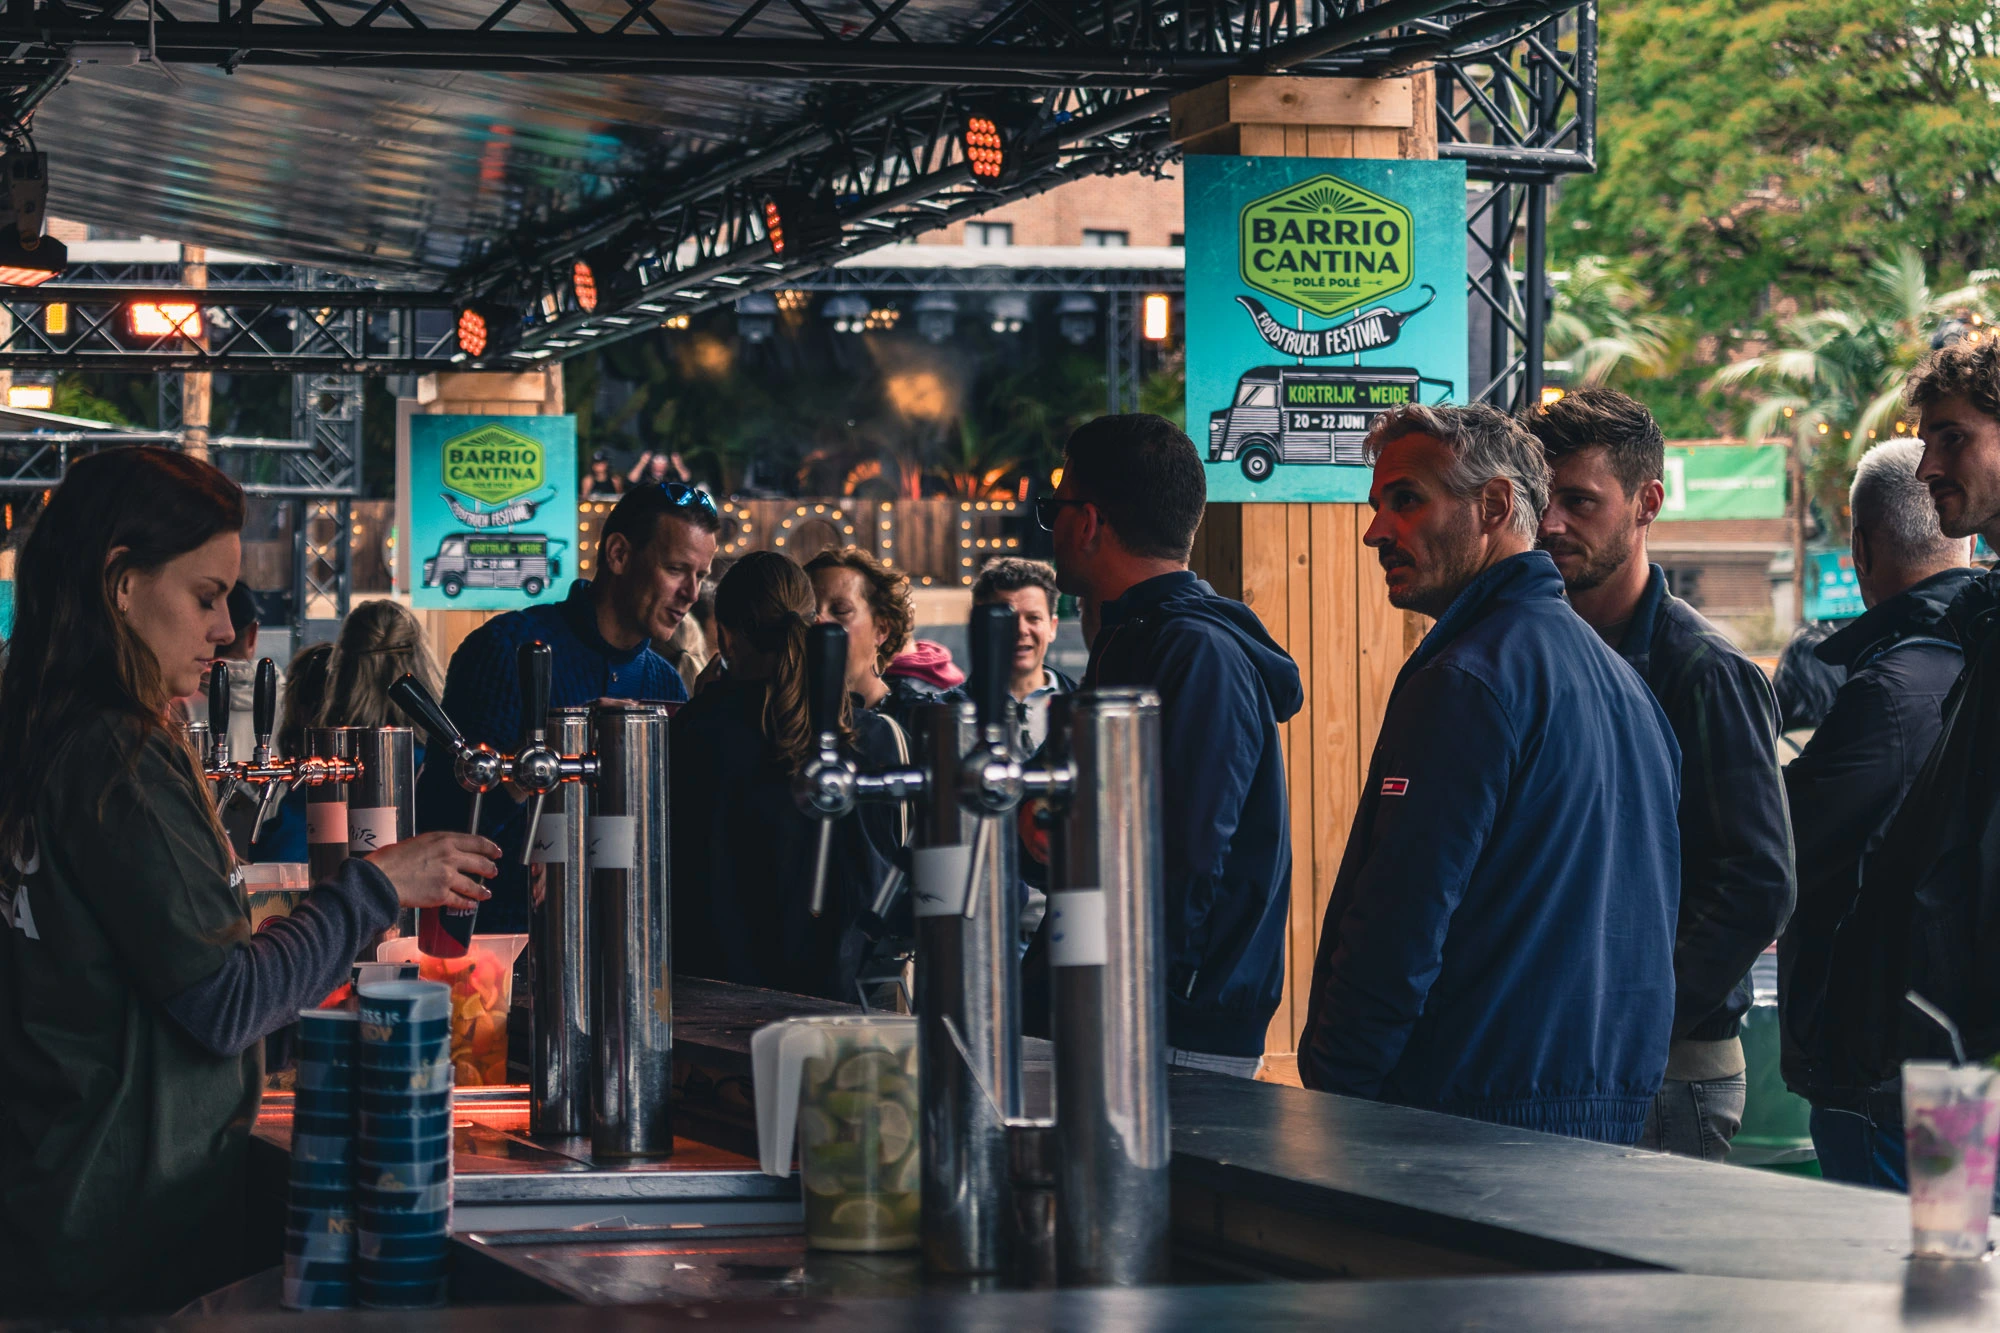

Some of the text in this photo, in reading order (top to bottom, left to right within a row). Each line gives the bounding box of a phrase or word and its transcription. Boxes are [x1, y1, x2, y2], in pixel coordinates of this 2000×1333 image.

[1252, 218, 1400, 246] BARRIO
[1253, 249, 1400, 274] CANTINA
[1294, 276, 1361, 288] POLÉ POLÉ
[1257, 311, 1390, 356] FOODTRUCK FESTIVAL
[1288, 385, 1356, 404] KORTRIJK
[1369, 386, 1410, 404] WEIDE
[1294, 414, 1310, 428] 20
[1321, 414, 1336, 429] 22
[1336, 415, 1365, 430] JUNI
[450, 450, 537, 465] BARRIO
[450, 466, 536, 481] CANTINA
